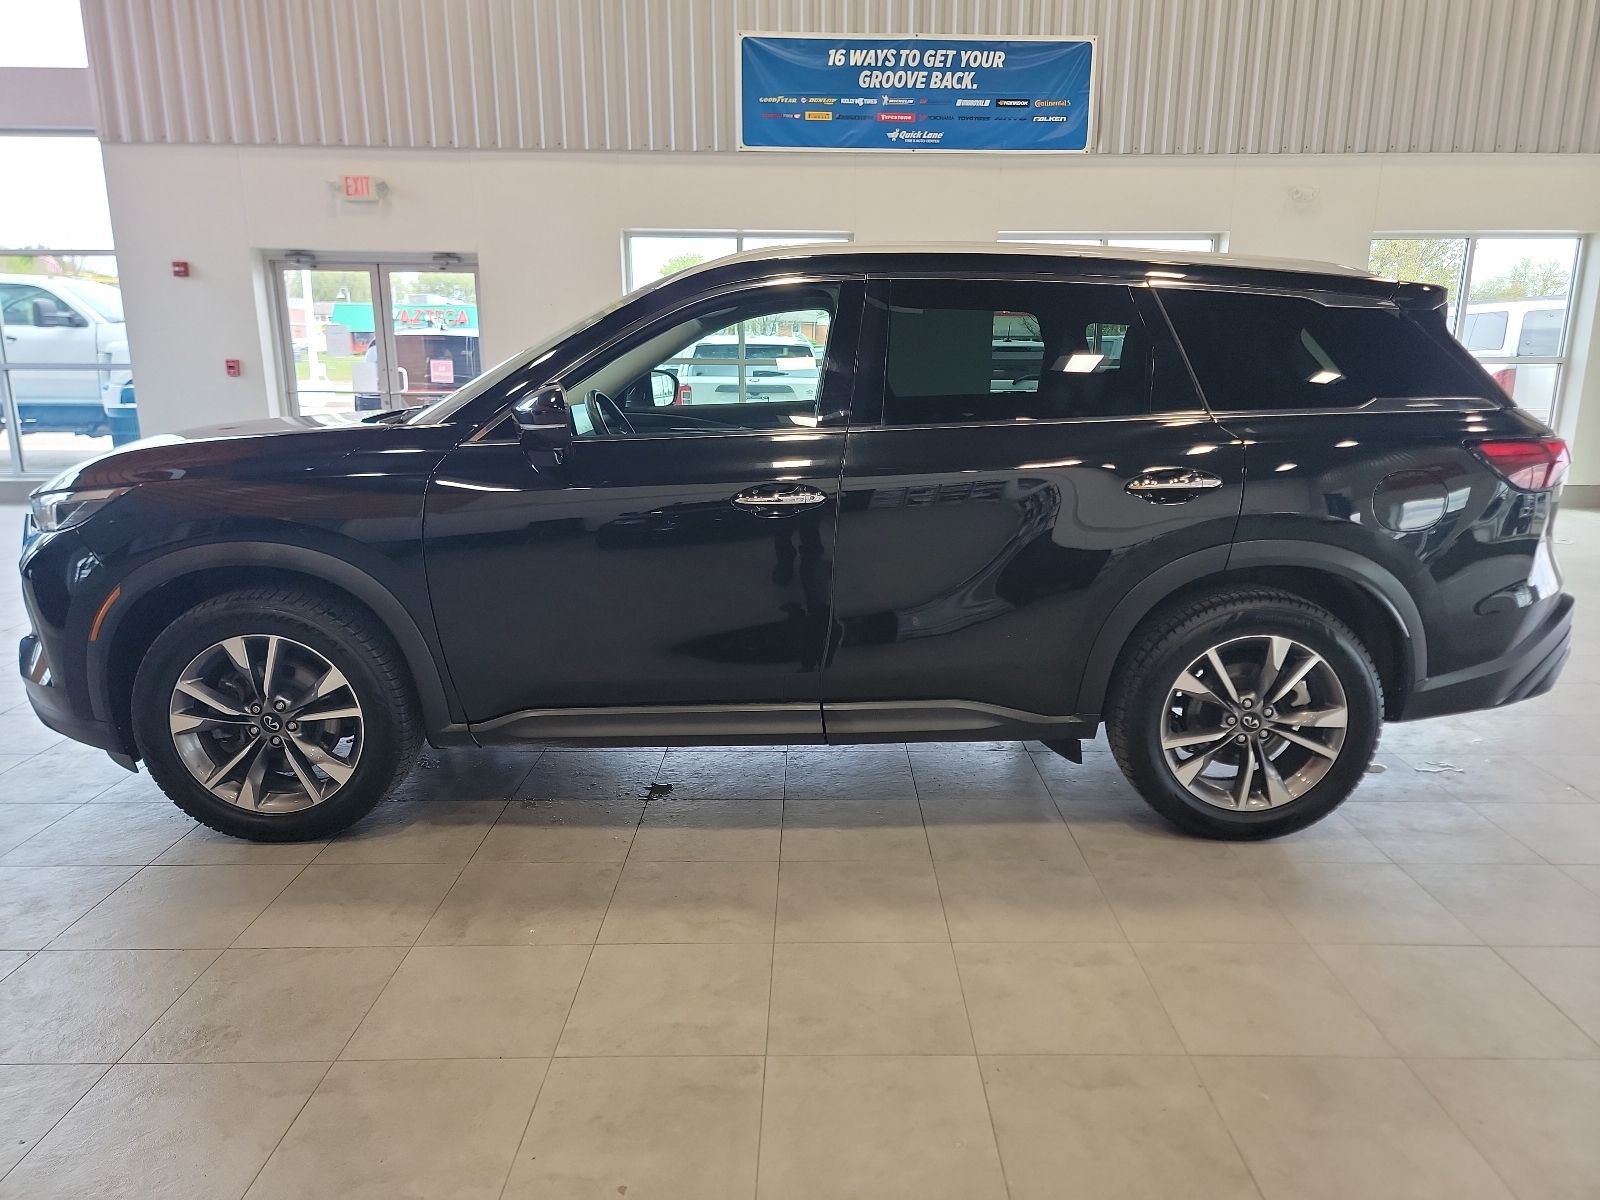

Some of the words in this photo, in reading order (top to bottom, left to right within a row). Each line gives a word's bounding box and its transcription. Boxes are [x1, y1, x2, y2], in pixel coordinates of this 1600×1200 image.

[828, 49, 846, 66] 16
[849, 49, 897, 67] WAYS
[899, 49, 921, 67] TO
[923, 50, 957, 68] GET
[960, 50, 1006, 68] YOUR
[858, 70, 928, 89] GROOVE
[929, 71, 979, 90] BACK.
[759, 96, 798, 104] GOODYEAR
[808, 97, 838, 105] DUNLOP
[1034, 99, 1067, 108] Continental
[899, 130, 923, 139] Quick
[922, 131, 943, 139] Lane
[344, 176, 370, 197] EXIT
